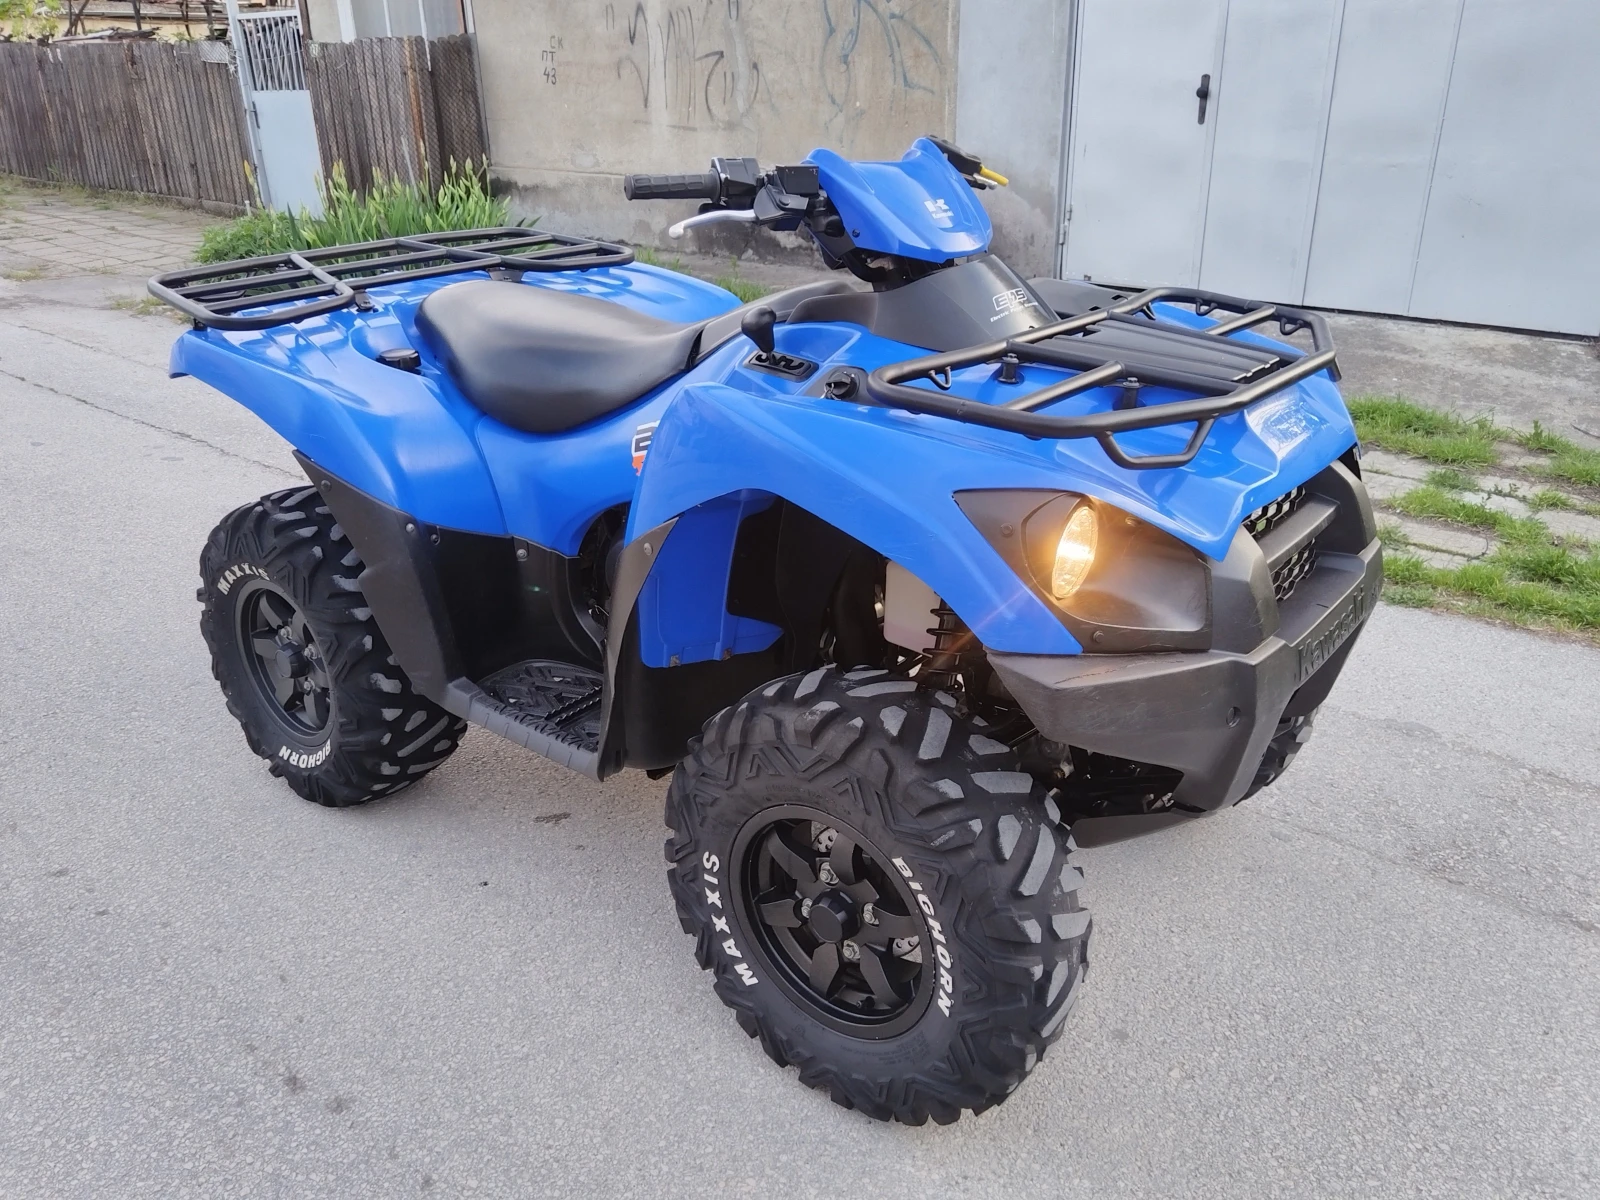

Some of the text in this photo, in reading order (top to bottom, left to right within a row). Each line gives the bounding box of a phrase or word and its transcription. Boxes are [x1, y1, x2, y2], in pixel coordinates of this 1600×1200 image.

[543, 66, 557, 85] 43
[217, 562, 271, 595] MAXXIS
[279, 739, 331, 769] BIGHORN
[702, 851, 759, 987] MAXXIS
[891, 856, 955, 1018] BIGHORN
